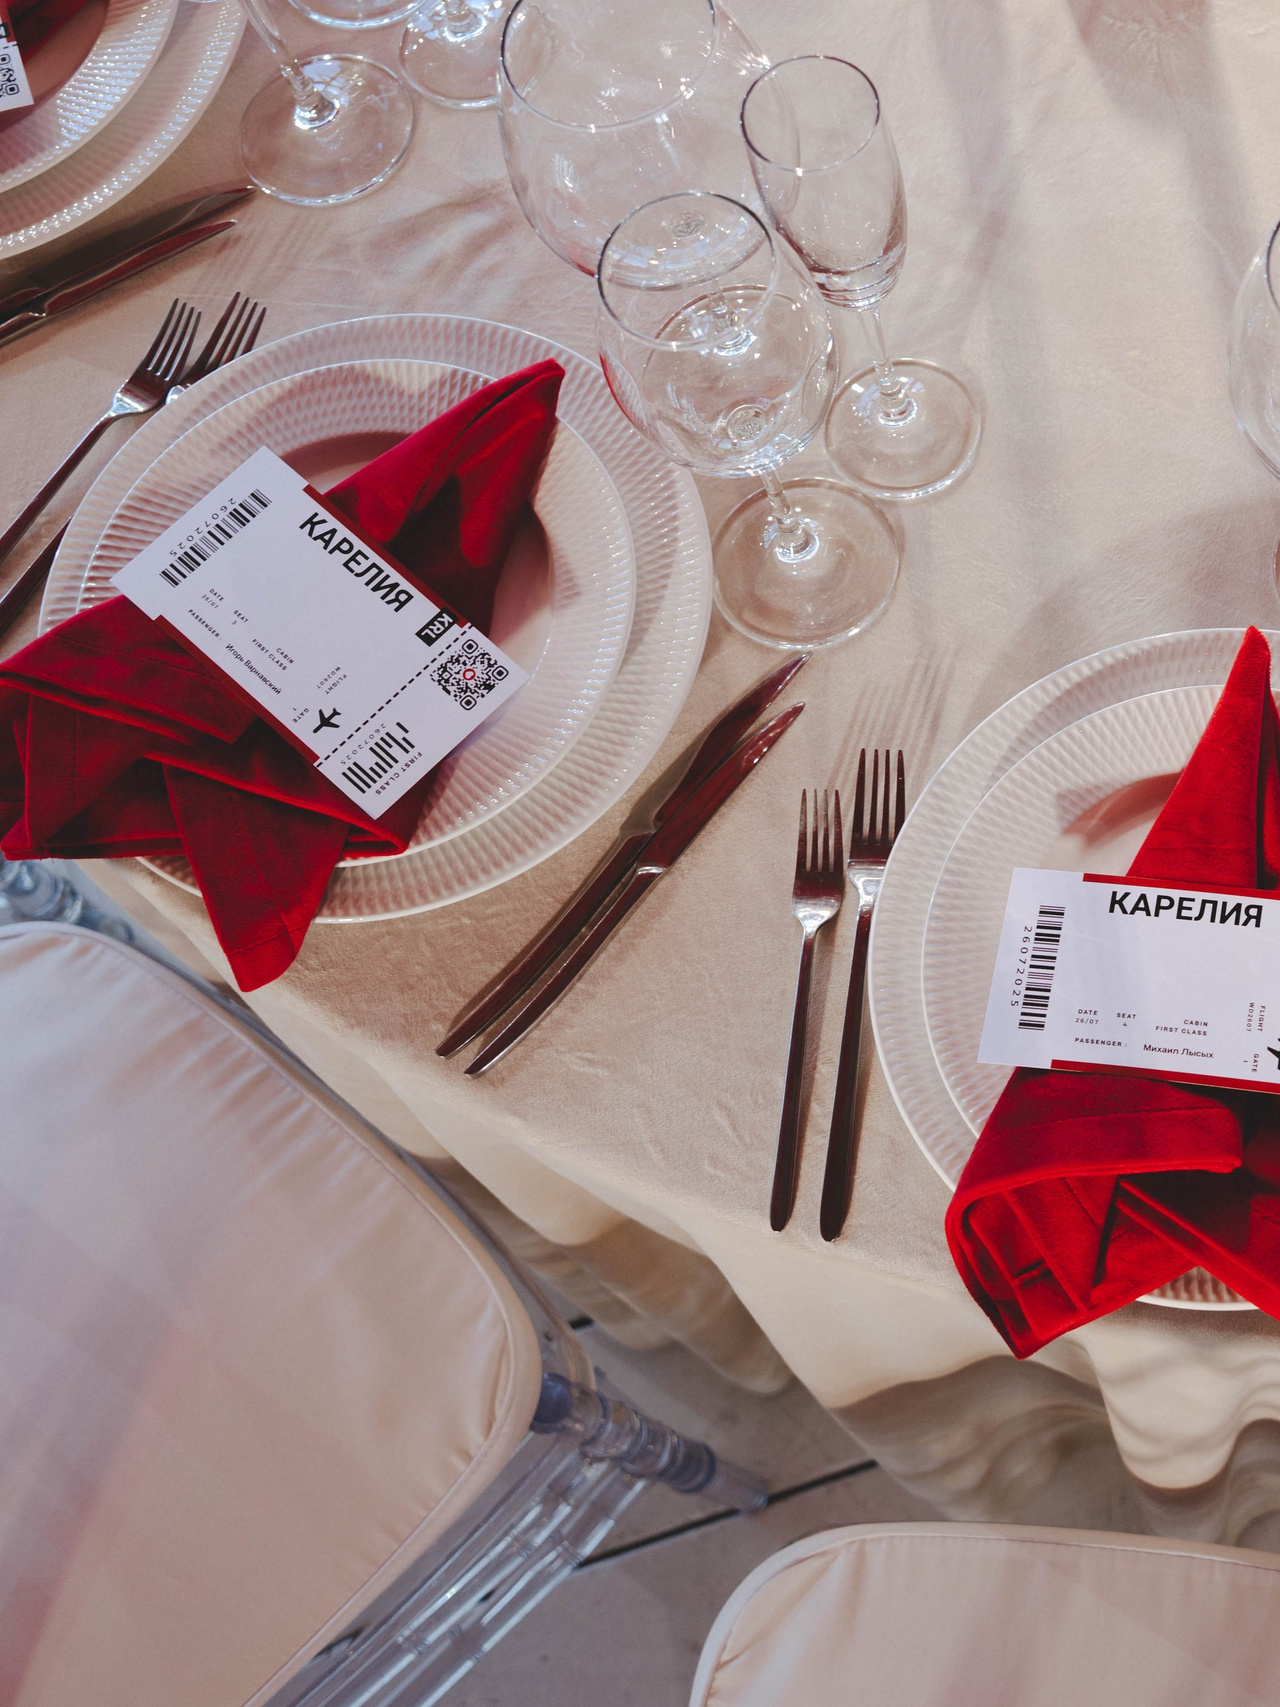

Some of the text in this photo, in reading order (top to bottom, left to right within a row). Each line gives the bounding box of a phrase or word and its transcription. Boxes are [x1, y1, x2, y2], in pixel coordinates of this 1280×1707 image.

[169, 497, 237, 557] 26072025
[299, 512, 414, 612] КАРЕЛИЯ
[209, 588, 225, 602] DATE
[188, 608, 220, 638] PASSENGER
[233, 609, 249, 624] SEAT
[420, 612, 454, 640] KRL
[251, 638, 288, 671] FIRST CLASS
[276, 647, 295, 665] CABIN
[225, 643, 283, 695] Игорь Варнавский
[324, 674, 347, 695] FLIGHT
[292, 707, 309, 724] GATE
[340, 722, 387, 766] 26072025
[374, 751, 423, 795] FIRST CLASS
[1108, 890, 1264, 928] КАРЕЛИЯ
[1010, 925, 1033, 1007] 26072025
[1075, 1017, 1099, 1025] 26/07
[1116, 1012, 1137, 1020] SEAT
[1183, 1019, 1209, 1027] CABIN
[1257, 1005, 1266, 1032] FLIGHT
[1074, 1037, 1122, 1047] PASSENGER
[1181, 1028, 1208, 1036] CLASS
[1143, 1044, 1214, 1059] Михаил Лысых
[1251, 1053, 1259, 1073] GATE
